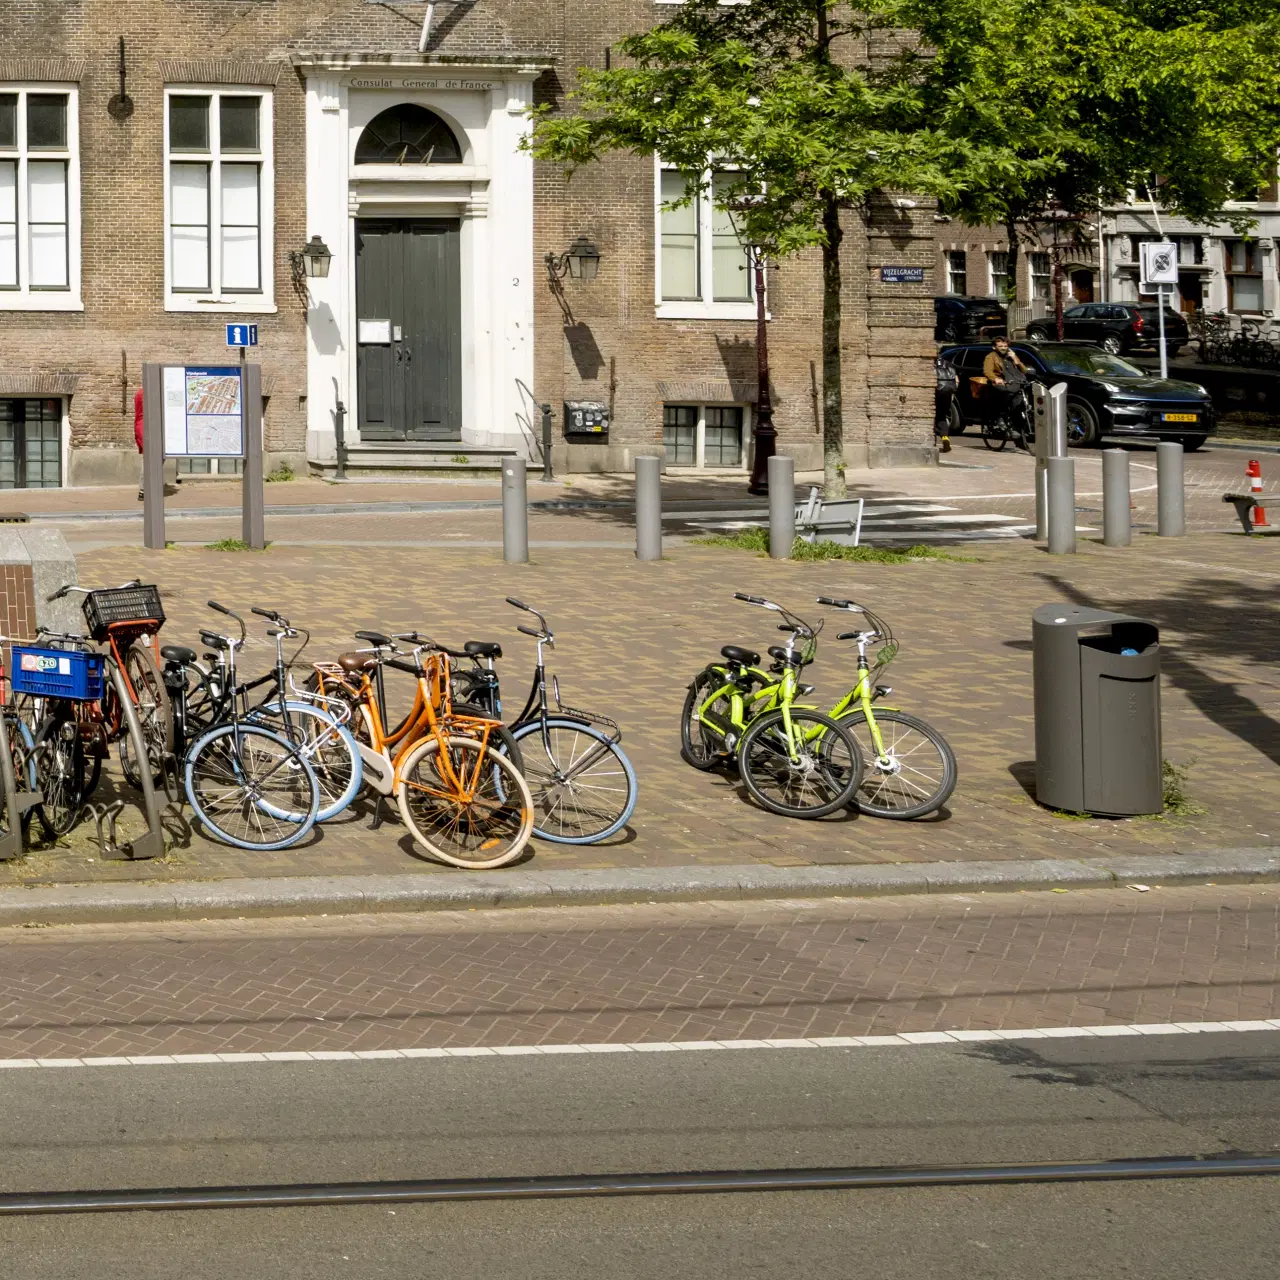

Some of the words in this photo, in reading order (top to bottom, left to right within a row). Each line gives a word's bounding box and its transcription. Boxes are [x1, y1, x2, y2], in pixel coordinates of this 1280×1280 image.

[350, 77, 393, 87] Consulat
[402, 78, 438, 88] General
[445, 79, 458, 89] de
[883, 268, 922, 276] VIJZELGRACHT
[512, 277, 520, 287] 2
[38, 658, 56, 668] 420
